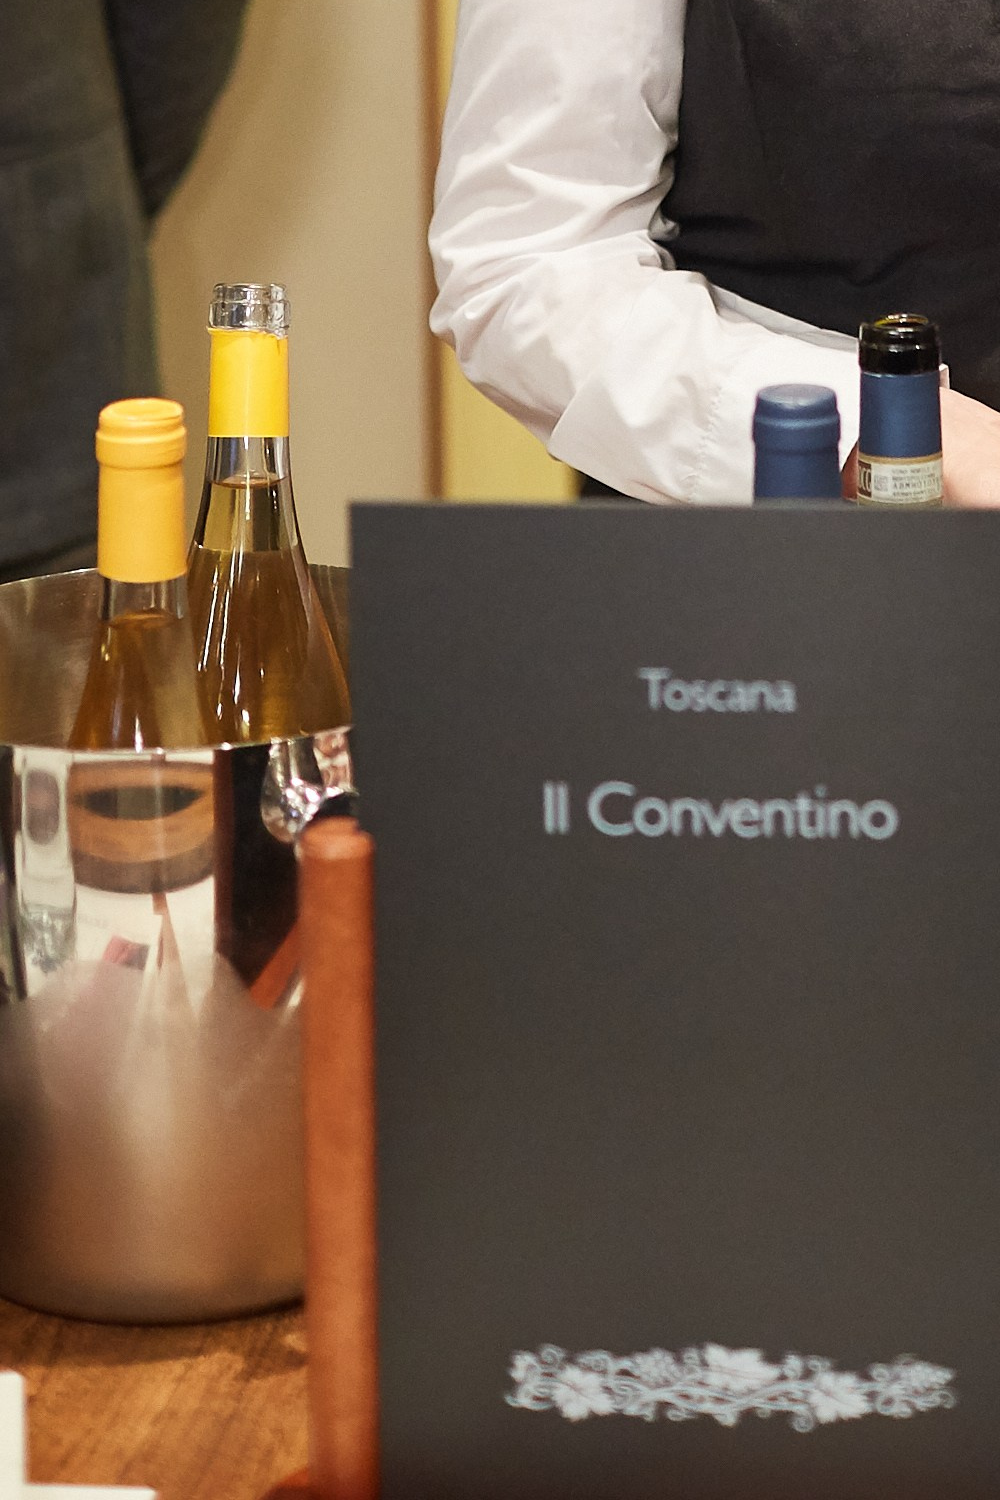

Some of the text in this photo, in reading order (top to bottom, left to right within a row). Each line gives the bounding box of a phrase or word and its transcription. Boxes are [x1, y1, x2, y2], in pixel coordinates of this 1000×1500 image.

[637, 666, 797, 713] Toscana
[543, 779, 900, 840] Il Conventino
